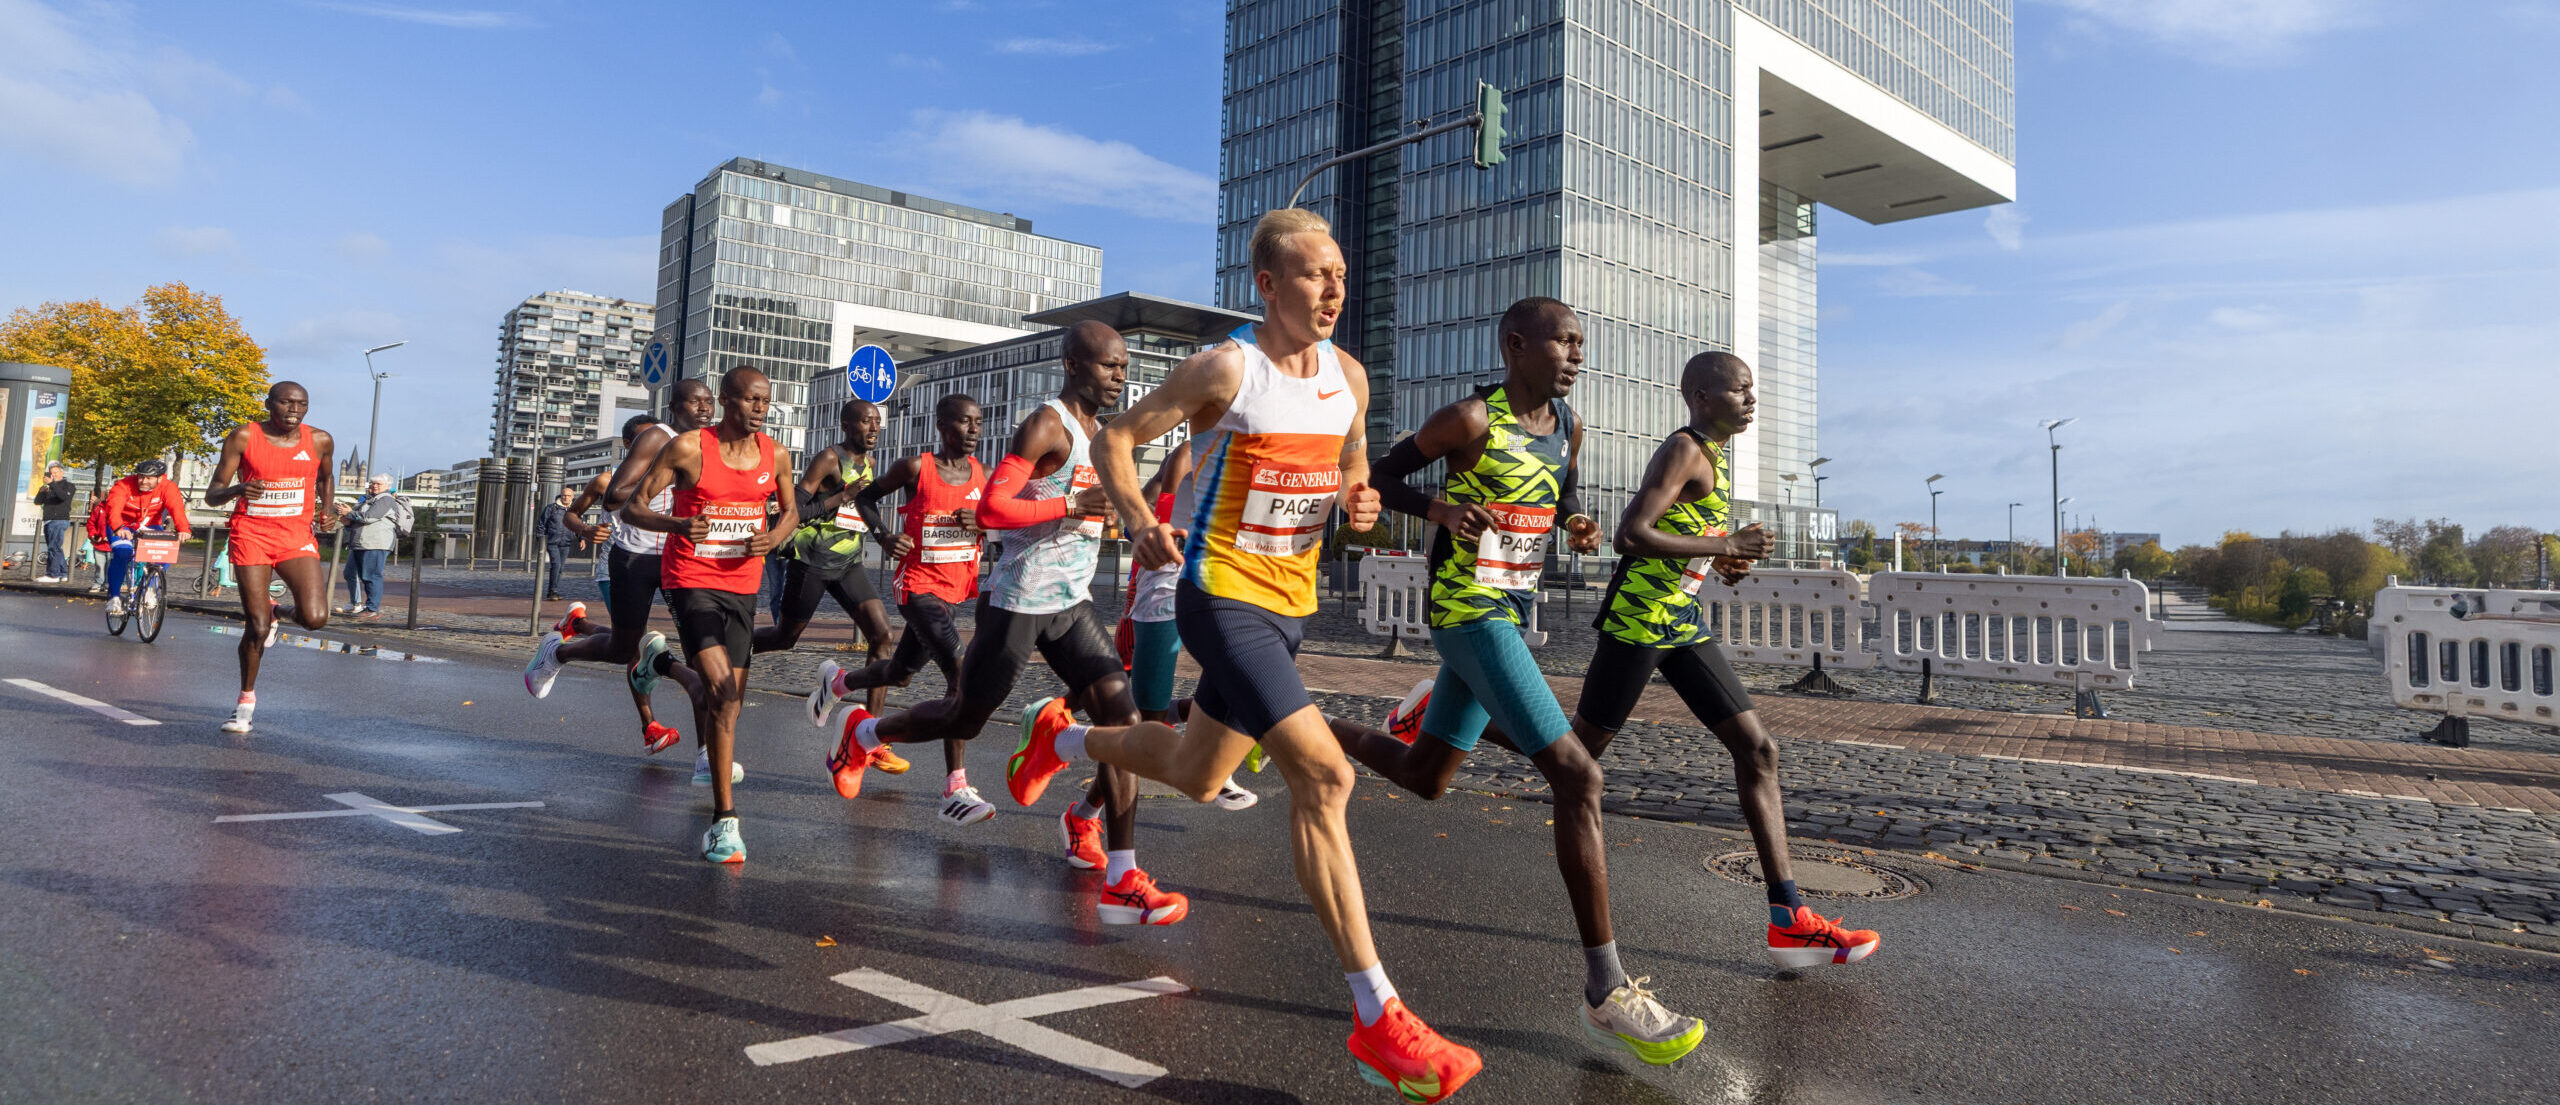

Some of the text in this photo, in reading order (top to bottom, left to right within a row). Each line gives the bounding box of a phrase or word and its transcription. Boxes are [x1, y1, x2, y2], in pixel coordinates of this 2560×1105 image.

[1280, 471, 1338, 487] GENERALI
[261, 492, 296, 500] HEBII
[719, 505, 763, 517] GENERALI
[1269, 498, 1322, 515] PACE
[1809, 511, 1836, 541] 5.01
[1499, 535, 1542, 552] PACE
